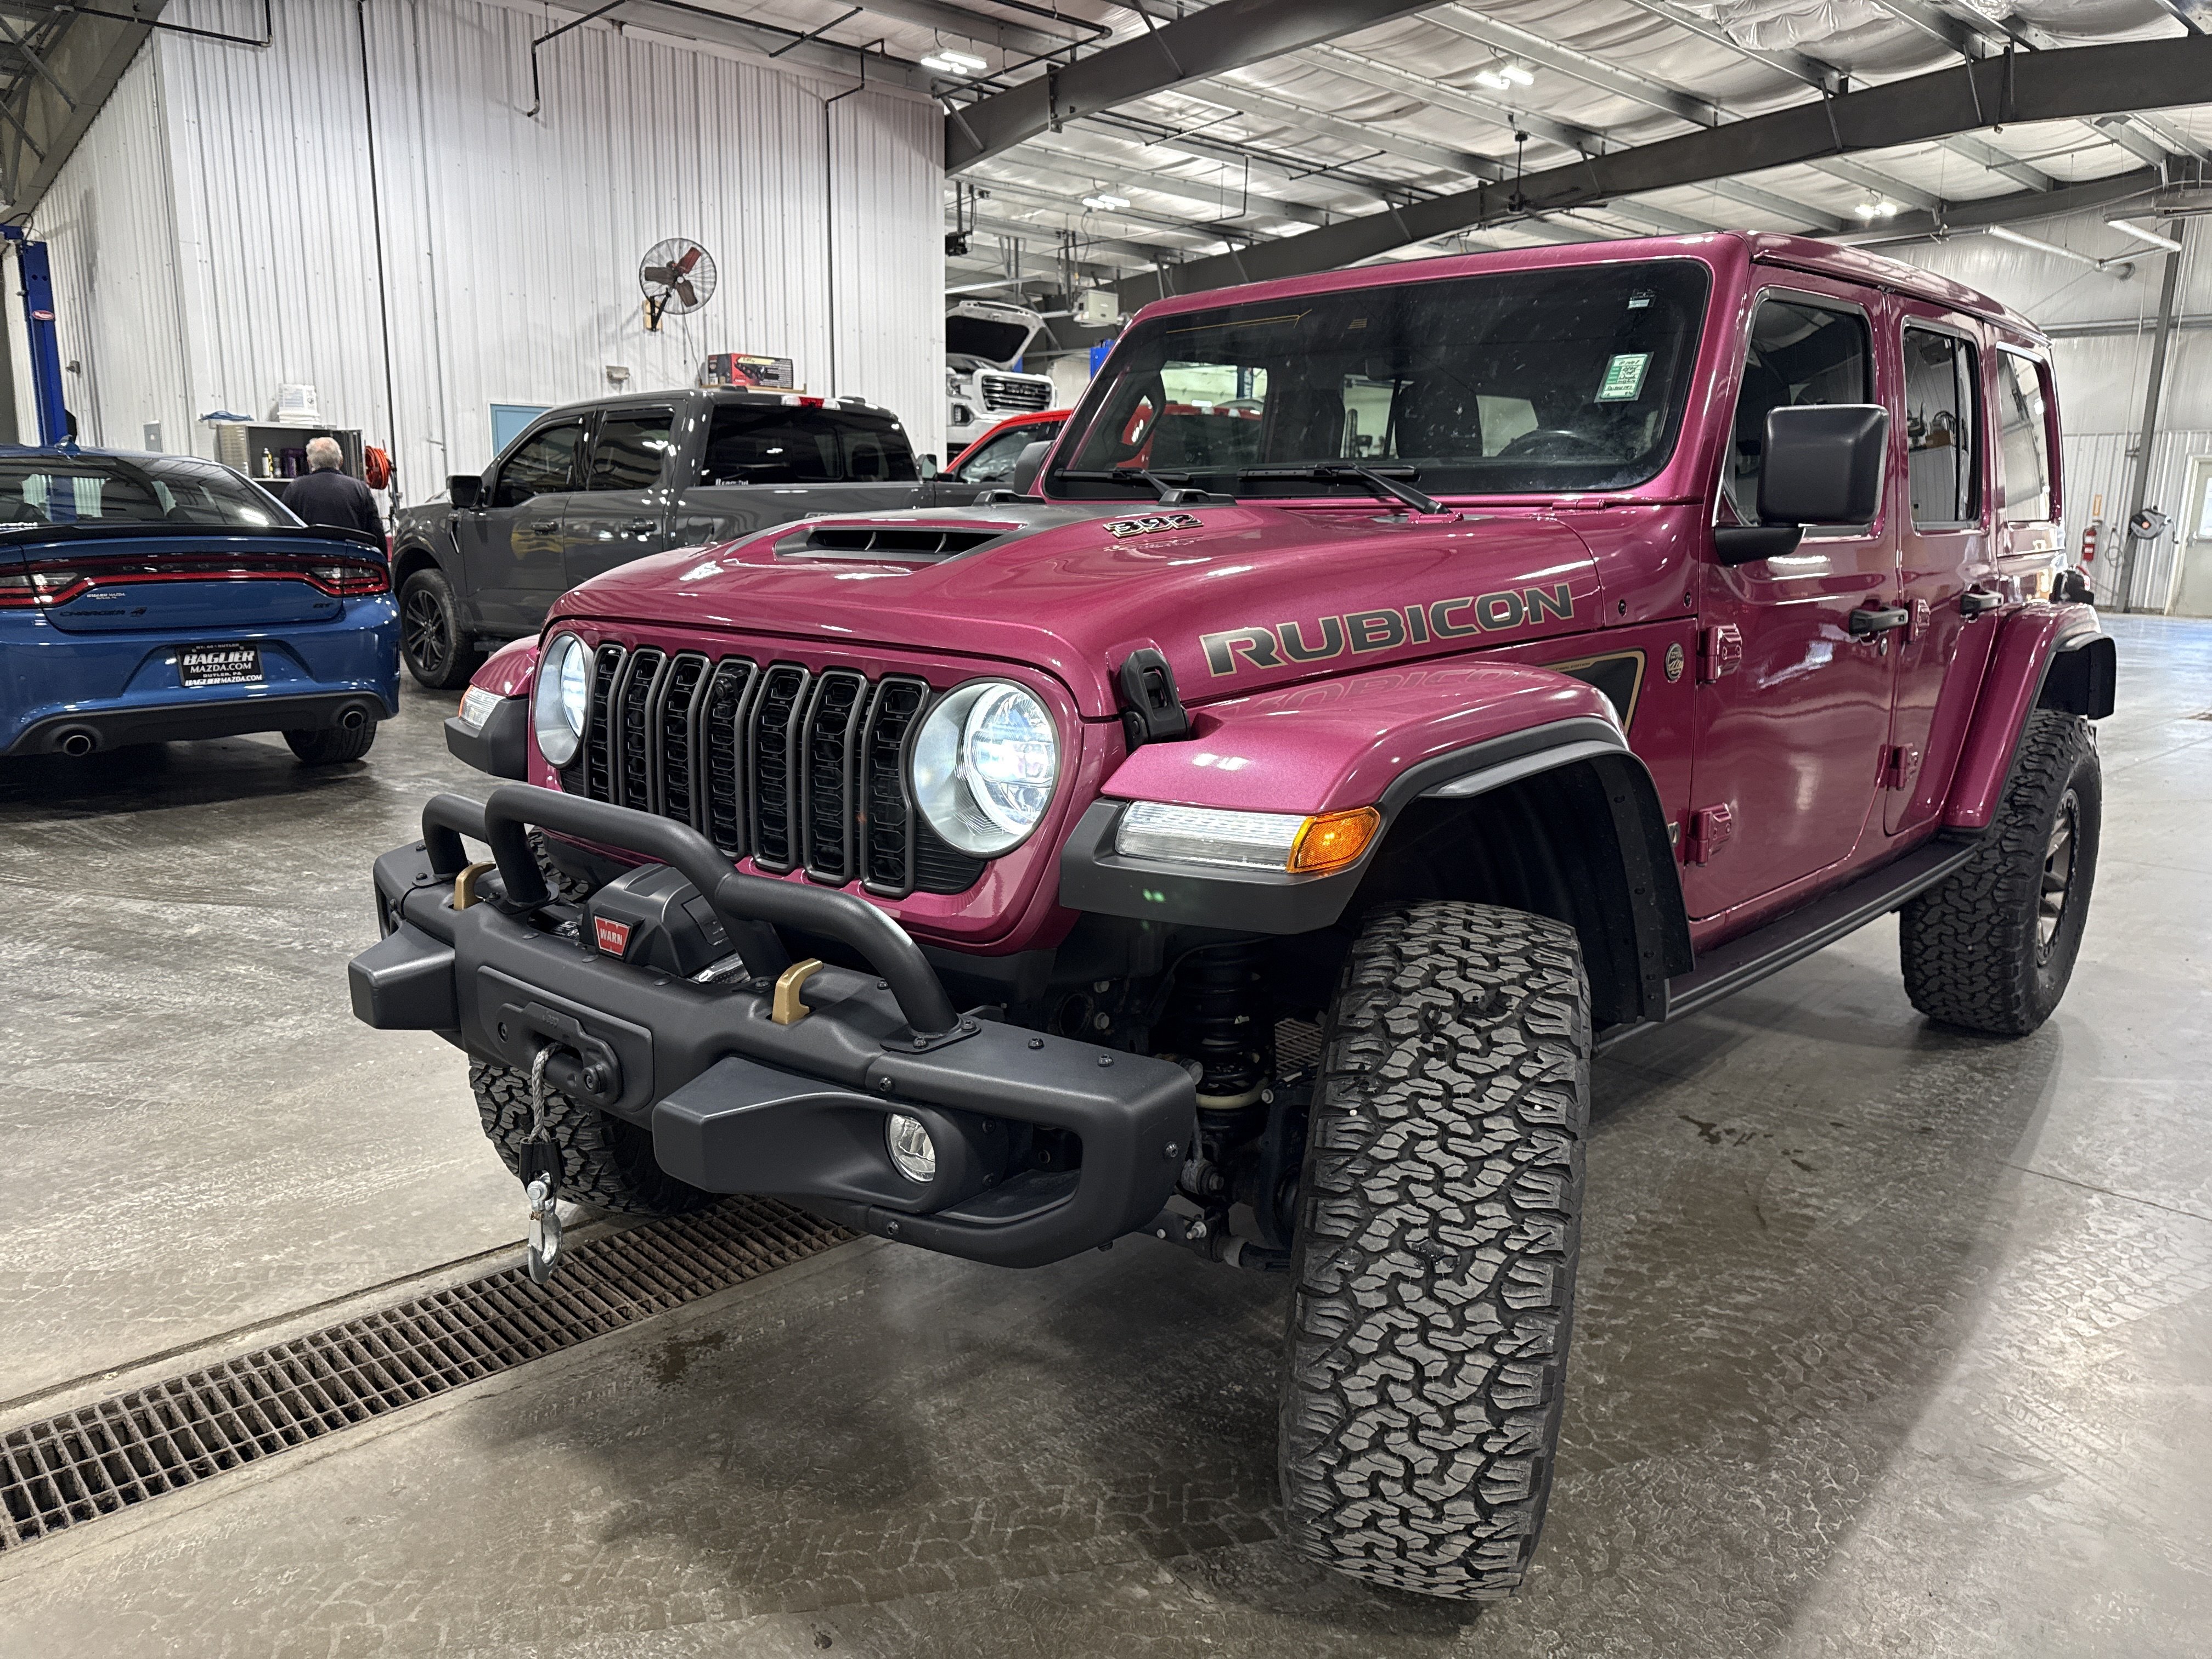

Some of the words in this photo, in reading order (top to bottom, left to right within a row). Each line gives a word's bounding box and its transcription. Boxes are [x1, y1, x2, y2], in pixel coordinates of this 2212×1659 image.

[1103, 514, 1204, 538] 392
[1198, 583, 1574, 678] RUBICON
[183, 651, 255, 665] BAGLIER
[190, 662, 252, 674] MAZDA.COM
[600, 928, 623, 945] WARN
